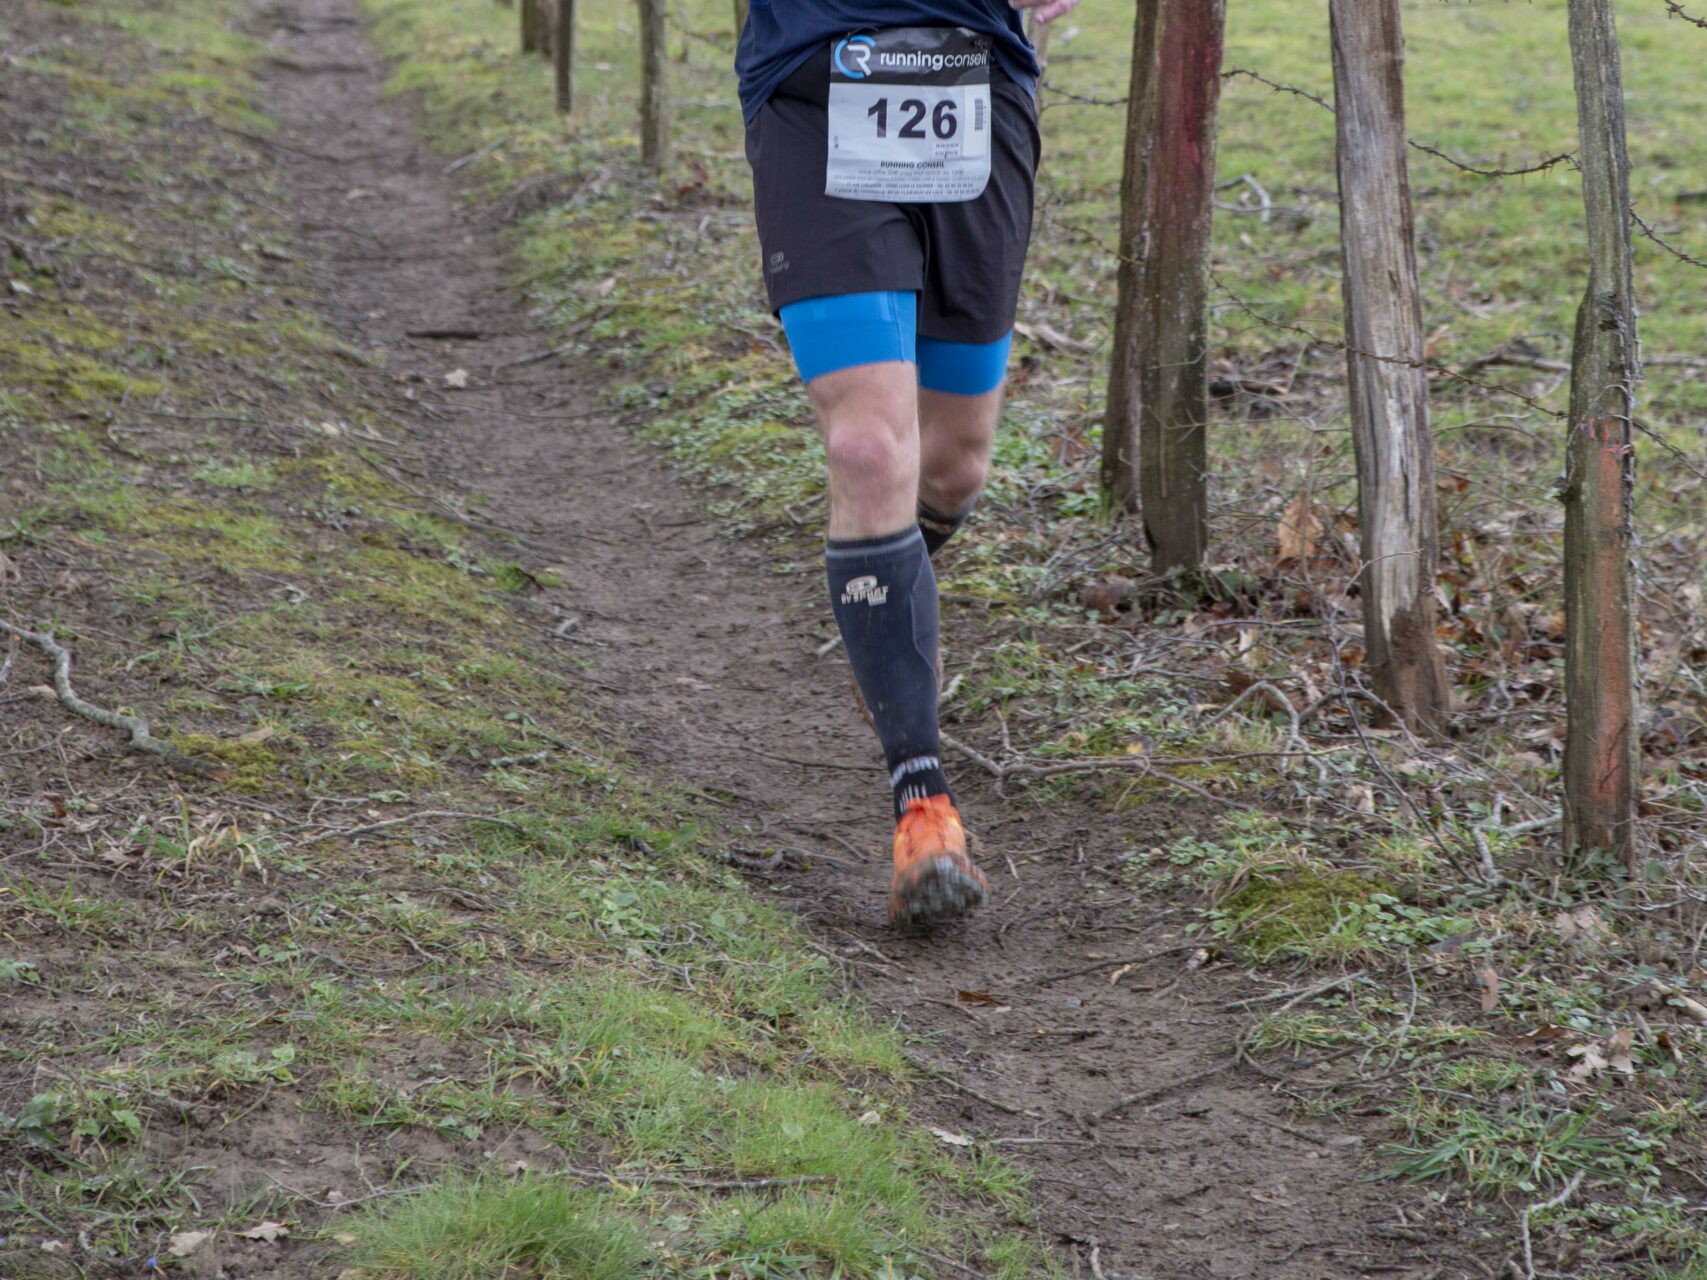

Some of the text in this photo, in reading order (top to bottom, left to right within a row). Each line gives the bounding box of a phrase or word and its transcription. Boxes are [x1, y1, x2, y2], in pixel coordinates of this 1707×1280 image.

[880, 50, 988, 71] runningconseil
[867, 97, 958, 140] 126
[880, 160, 944, 169] RUNNING CONSEIL
